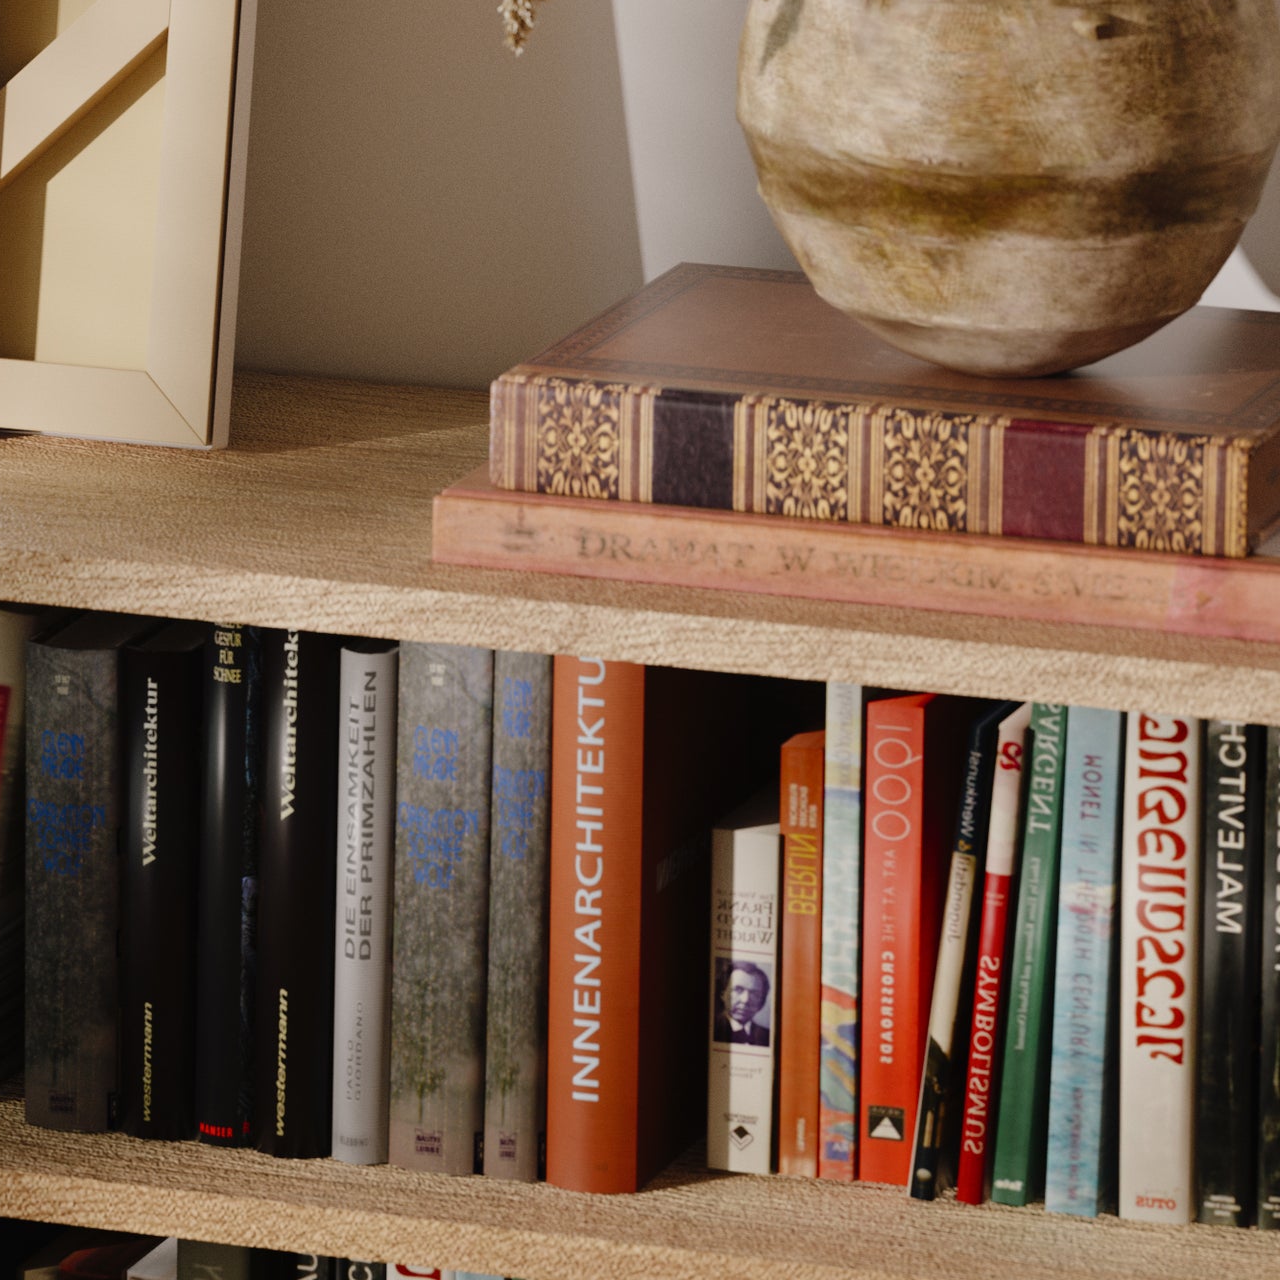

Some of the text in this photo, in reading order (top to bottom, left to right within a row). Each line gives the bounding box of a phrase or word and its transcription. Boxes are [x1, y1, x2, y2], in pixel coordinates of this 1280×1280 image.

[577, 526, 754, 569] DRAMAT
[777, 545, 814, 573] W
[213, 668, 241, 683] SCHNEE
[219, 648, 234, 665] FÜR
[142, 677, 159, 867] Weltarchitektur
[358, 670, 378, 960] DER PRIMZAHLEN
[344, 695, 360, 960] DIE EINSAMKEIT
[141, 1001, 152, 1122] westermann
[274, 986, 289, 1138] westermann
[344, 1039, 356, 1102] PAOLO
[353, 1001, 364, 1101] GIORDANO
[199, 1120, 233, 1138] HANSER
